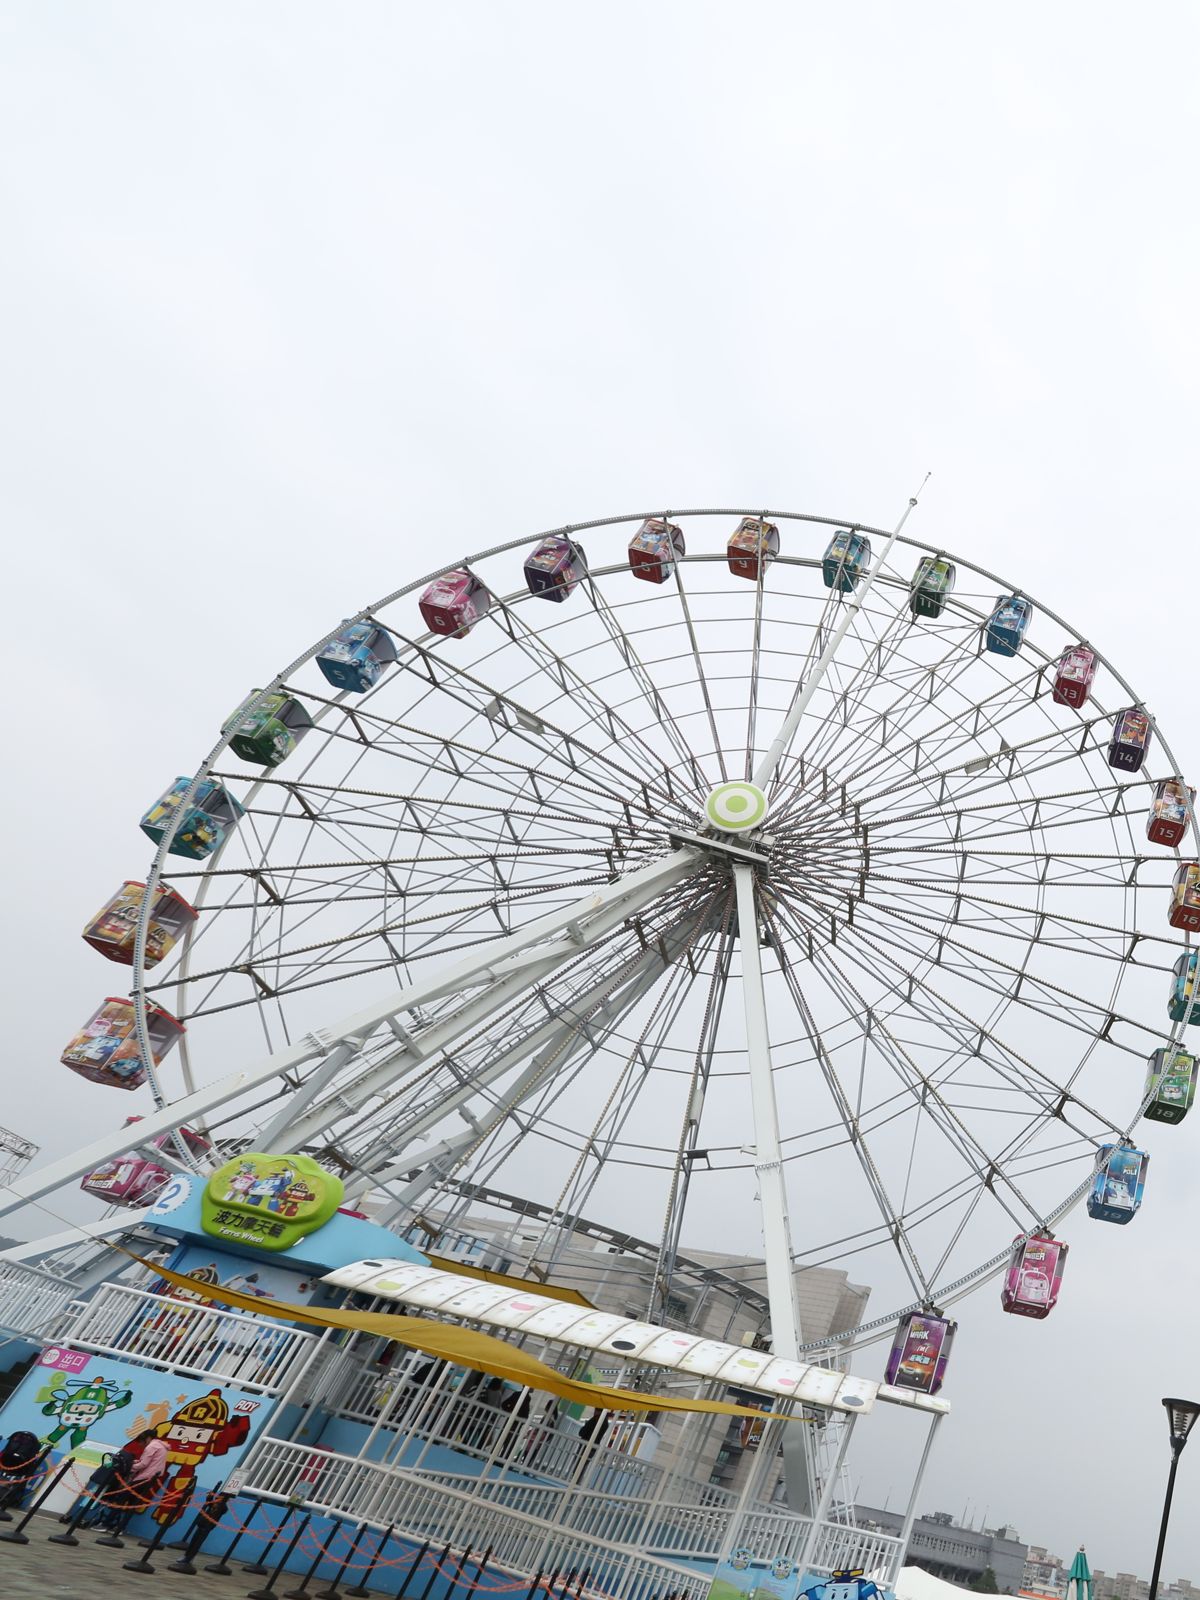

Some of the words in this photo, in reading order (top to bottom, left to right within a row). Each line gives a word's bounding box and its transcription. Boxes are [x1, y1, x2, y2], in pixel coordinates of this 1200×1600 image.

[919, 597, 931, 608] 11
[434, 616, 445, 627] 6
[333, 669, 345, 681] 5
[1063, 687, 1077, 699] 13
[1119, 752, 1134, 763] 14
[1159, 827, 1175, 838] 15
[1183, 914, 1199, 925] 16
[1156, 1108, 1175, 1118] 18
[1123, 1168, 1137, 1176] POLI
[156, 1183, 182, 1209] 2
[1103, 1210, 1122, 1219] 19
[212, 1209, 287, 1238] 波力摩天輪
[219, 1226, 241, 1238] Ferris
[241, 1232, 265, 1244] Wheel
[910, 1329, 930, 1340] MARK
[60, 1353, 85, 1367] 出口
[234, 1399, 260, 1412] ROY
[193, 1407, 208, 1418] R
[228, 1479, 240, 1489] 20
